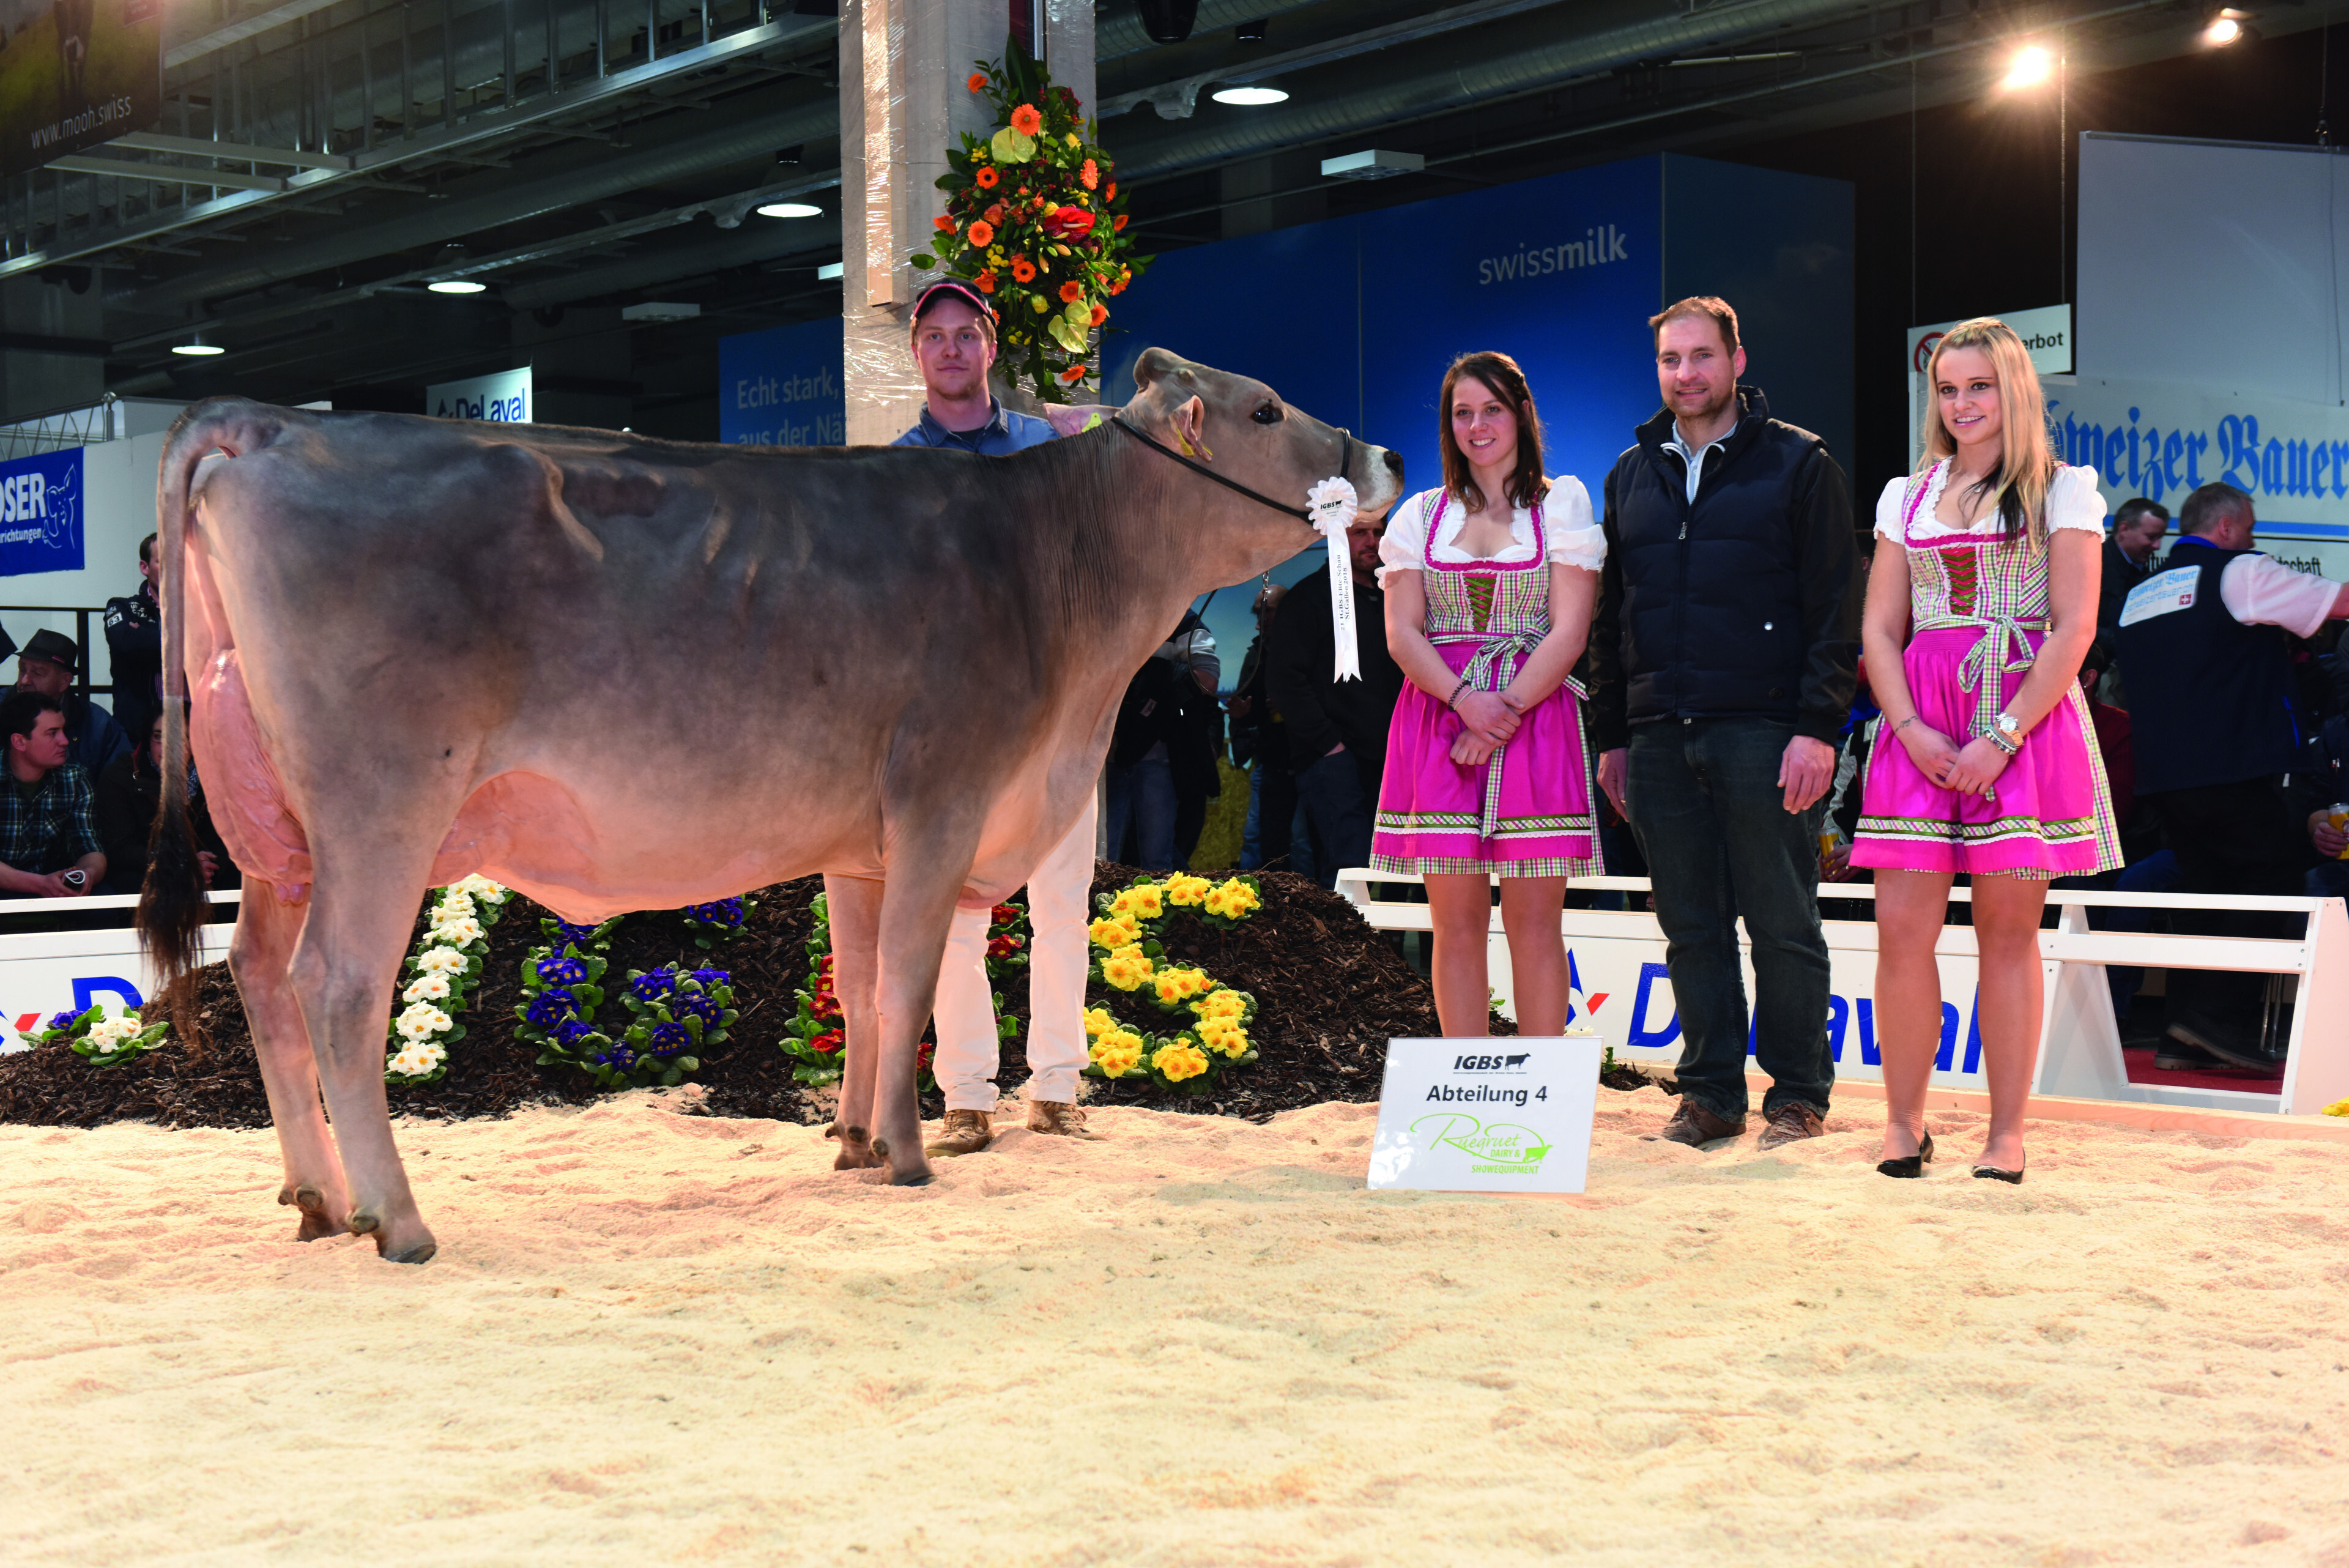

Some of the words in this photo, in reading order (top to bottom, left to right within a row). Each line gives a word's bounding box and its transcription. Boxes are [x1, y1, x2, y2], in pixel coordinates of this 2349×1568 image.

[31, 94, 131, 149] www.mooh.swiss
[1479, 224, 1628, 284] swissmilk
[737, 376, 779, 409] Echt
[782, 366, 839, 403] stark,
[456, 387, 525, 422] DeLaval
[777, 418, 810, 446] der
[2217, 414, 2349, 499] Bauer
[1453, 1055, 1504, 1070] IGBS
[1426, 1084, 1529, 1107] Abteilung
[1535, 1085, 1548, 1102] 4
[1490, 1149, 1513, 1157] DAIRY
[1514, 1149, 1521, 1157] &
[1471, 1164, 1540, 1175] SHOWEQUIPMENT
